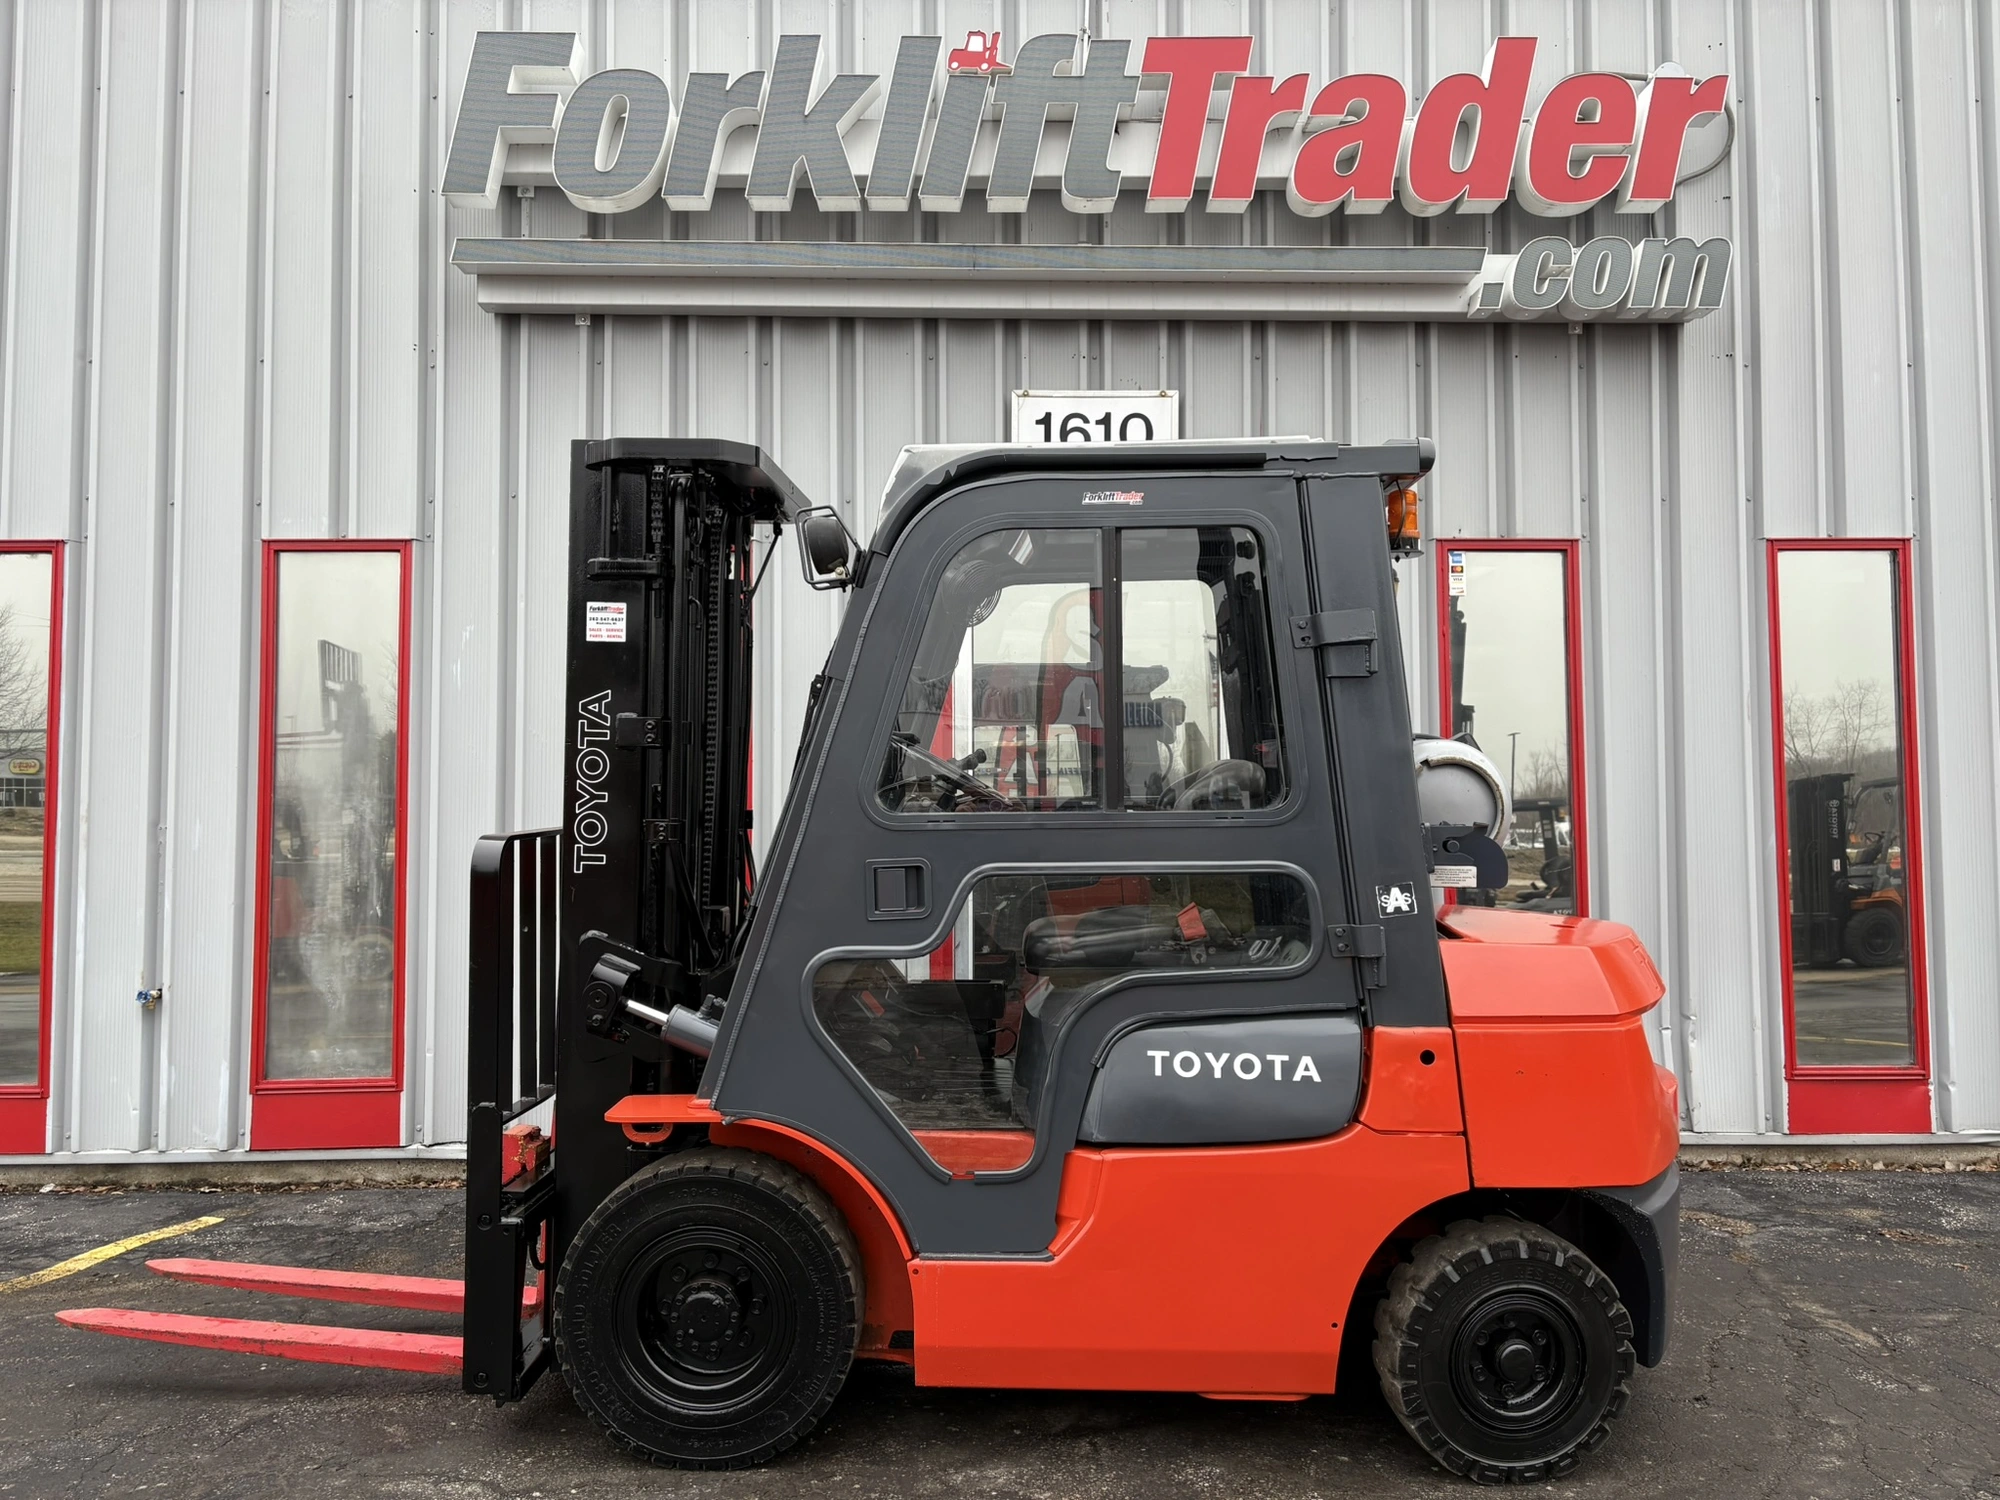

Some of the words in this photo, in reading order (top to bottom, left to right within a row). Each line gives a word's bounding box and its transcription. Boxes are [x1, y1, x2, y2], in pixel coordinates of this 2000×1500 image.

[441, 31, 1730, 210] ForkliftTrader
[1478, 236, 1733, 312] .com
[1034, 411, 1154, 442] 1610
[574, 689, 611, 873] TOYOTA
[1147, 1050, 1322, 1083] TOYOTA
